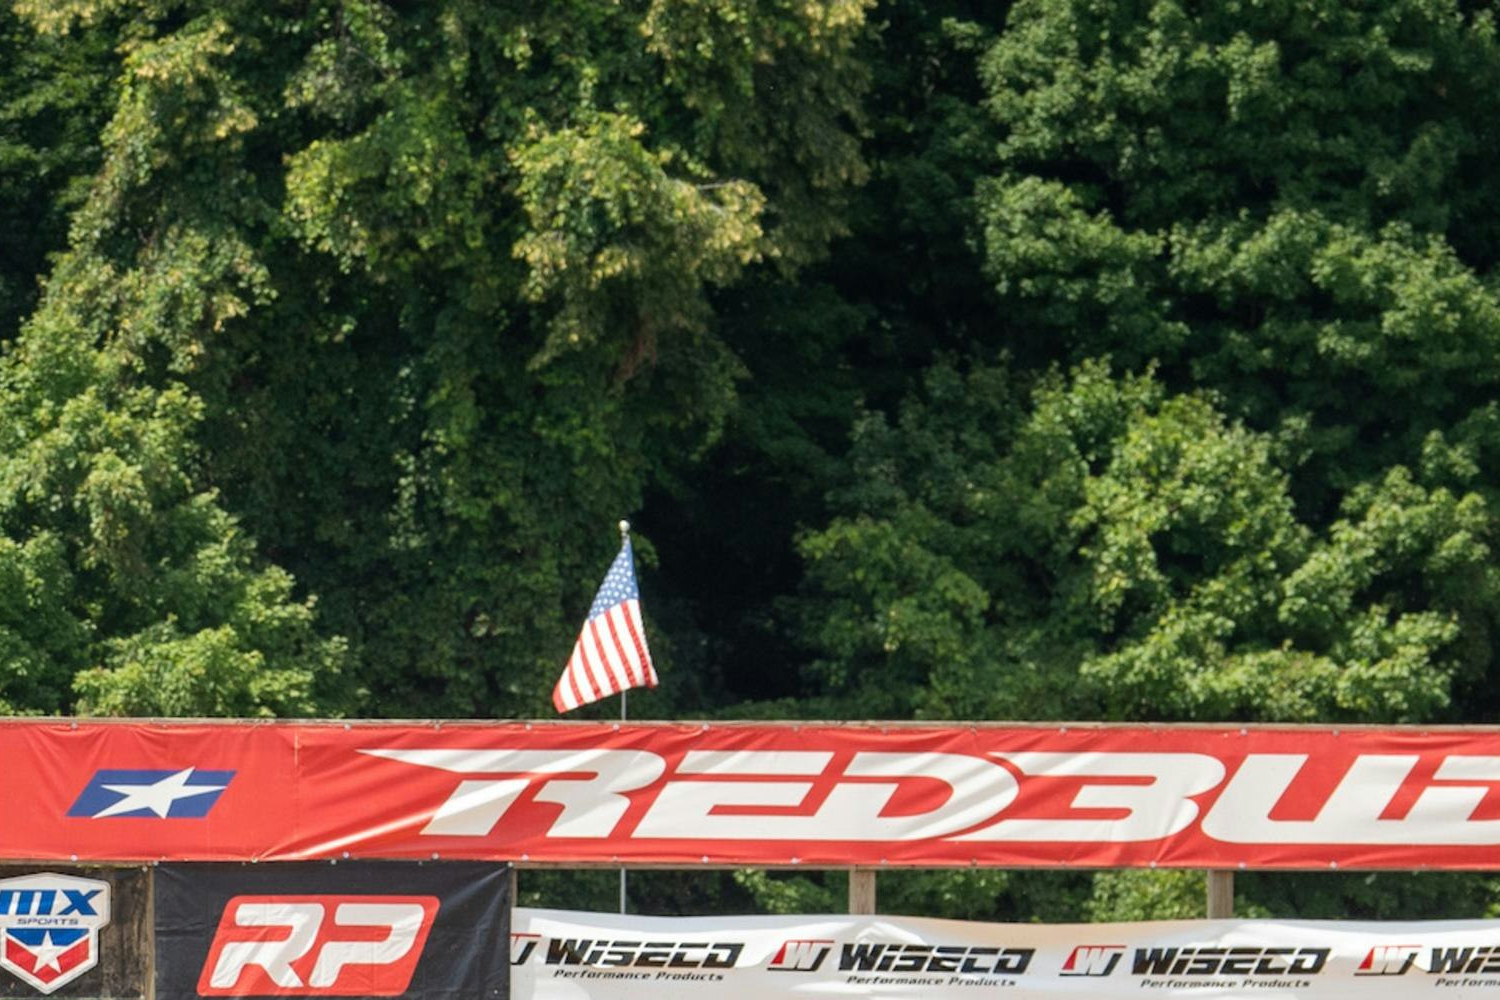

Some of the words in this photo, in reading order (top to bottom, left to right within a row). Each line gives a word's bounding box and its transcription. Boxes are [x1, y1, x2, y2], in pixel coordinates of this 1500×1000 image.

[17, 917, 79, 925] SPORTS
[210, 903, 424, 988] RP
[554, 969, 650, 981] Performance
[656, 970, 724, 982] Products
[846, 975, 944, 986] Performance
[948, 976, 1016, 987] Products
[1140, 978, 1237, 989] Performance
[1242, 978, 1311, 989] Products
